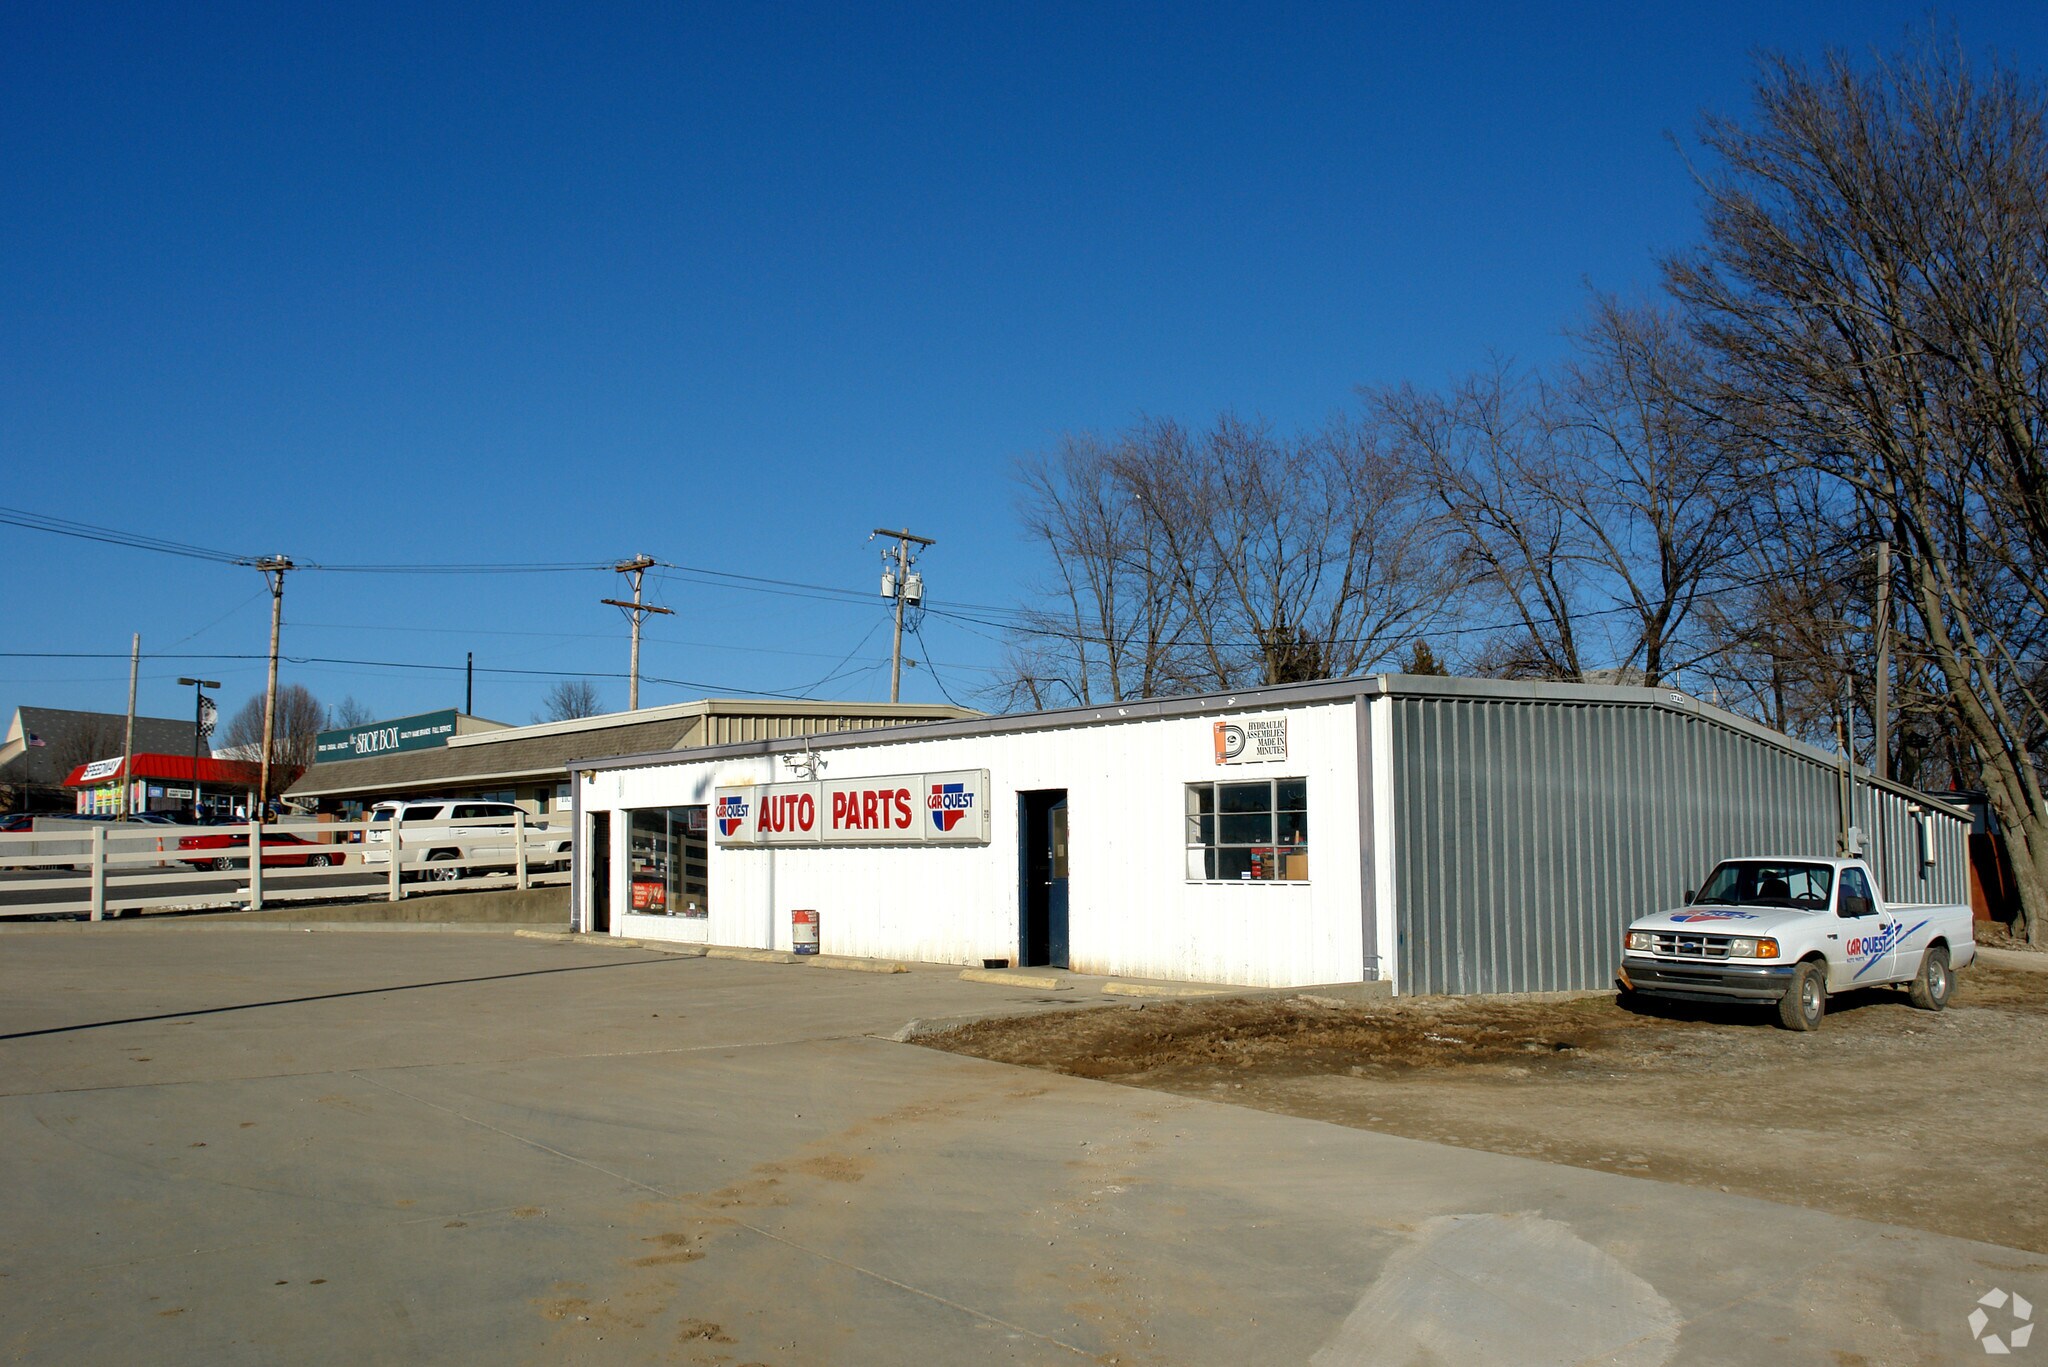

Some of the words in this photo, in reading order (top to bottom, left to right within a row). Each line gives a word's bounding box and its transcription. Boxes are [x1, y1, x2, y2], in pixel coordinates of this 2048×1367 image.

[1249, 721, 1285, 730] HYDRAULIC
[1247, 730, 1285, 739] ASSEMBLIES
[356, 730, 379, 754] SHOE
[379, 727, 399, 751] BOX
[1258, 738, 1276, 746] MADE
[1277, 736, 1285, 745] IN
[1257, 747, 1285, 755] MINUTES
[84, 760, 120, 777] SPEEDWAY
[757, 793, 815, 833] AUTO
[832, 788, 912, 830] PARTS
